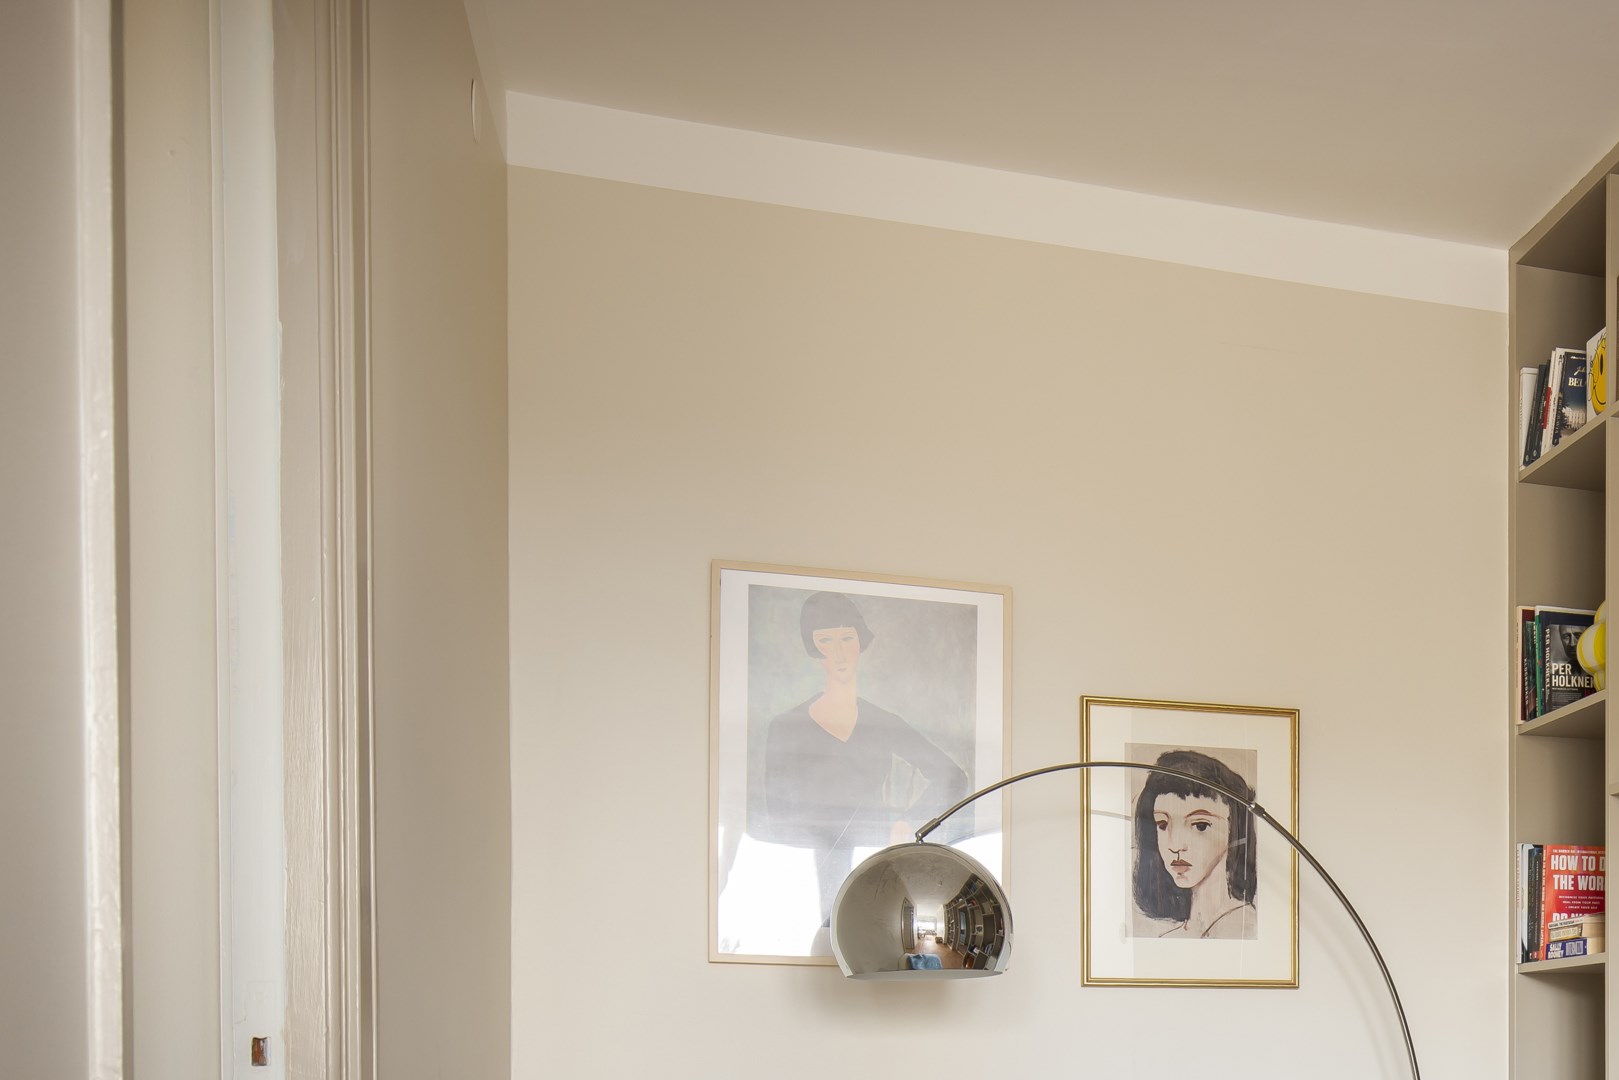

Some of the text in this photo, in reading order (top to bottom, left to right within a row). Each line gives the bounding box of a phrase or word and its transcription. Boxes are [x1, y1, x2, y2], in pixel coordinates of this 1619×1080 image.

[1551, 663, 1572, 675] PER
[1550, 855, 1578, 871] HOW
[1580, 855, 1596, 871] TO
[1552, 874, 1605, 891] THE WOR
